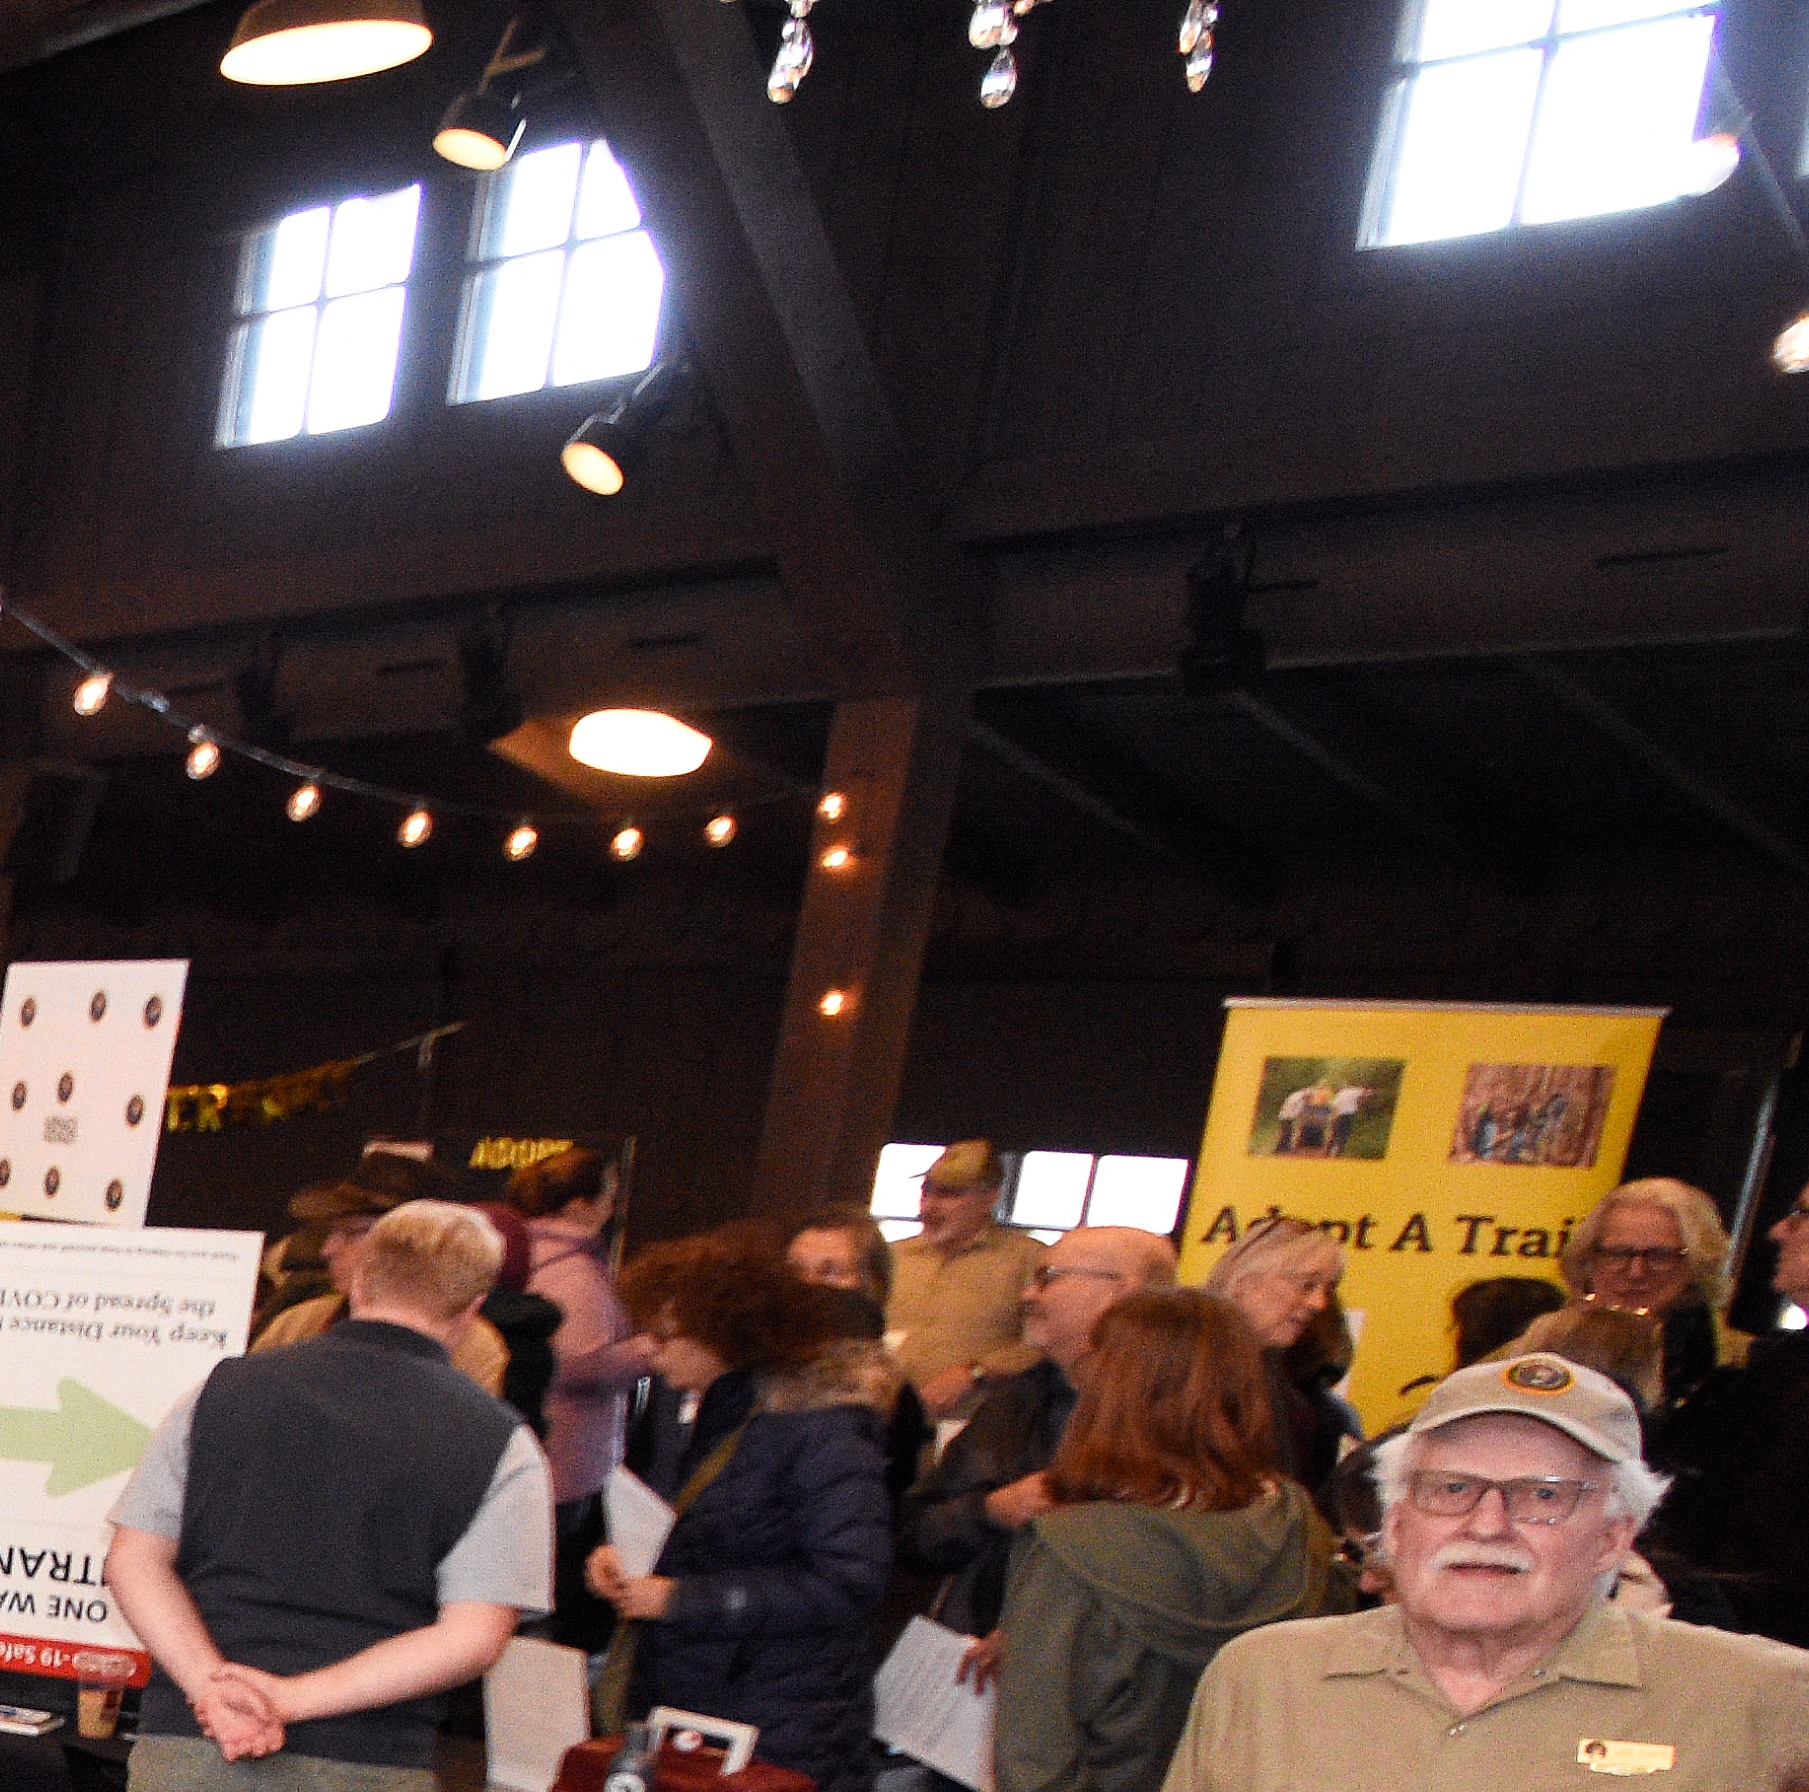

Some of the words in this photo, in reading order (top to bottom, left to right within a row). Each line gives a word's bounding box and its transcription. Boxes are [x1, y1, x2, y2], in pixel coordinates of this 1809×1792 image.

[1389, 1212, 1434, 1253] A
[1456, 1214, 1575, 1259] Trai
[67, 1292, 89, 1310] of
[95, 1292, 174, 1318] Spread
[179, 1299, 216, 1319] the
[10, 1316, 103, 1342] Distance
[110, 1323, 160, 1345] Your
[169, 1323, 228, 1350] Keep
[48, 1594, 109, 1623] ONE
